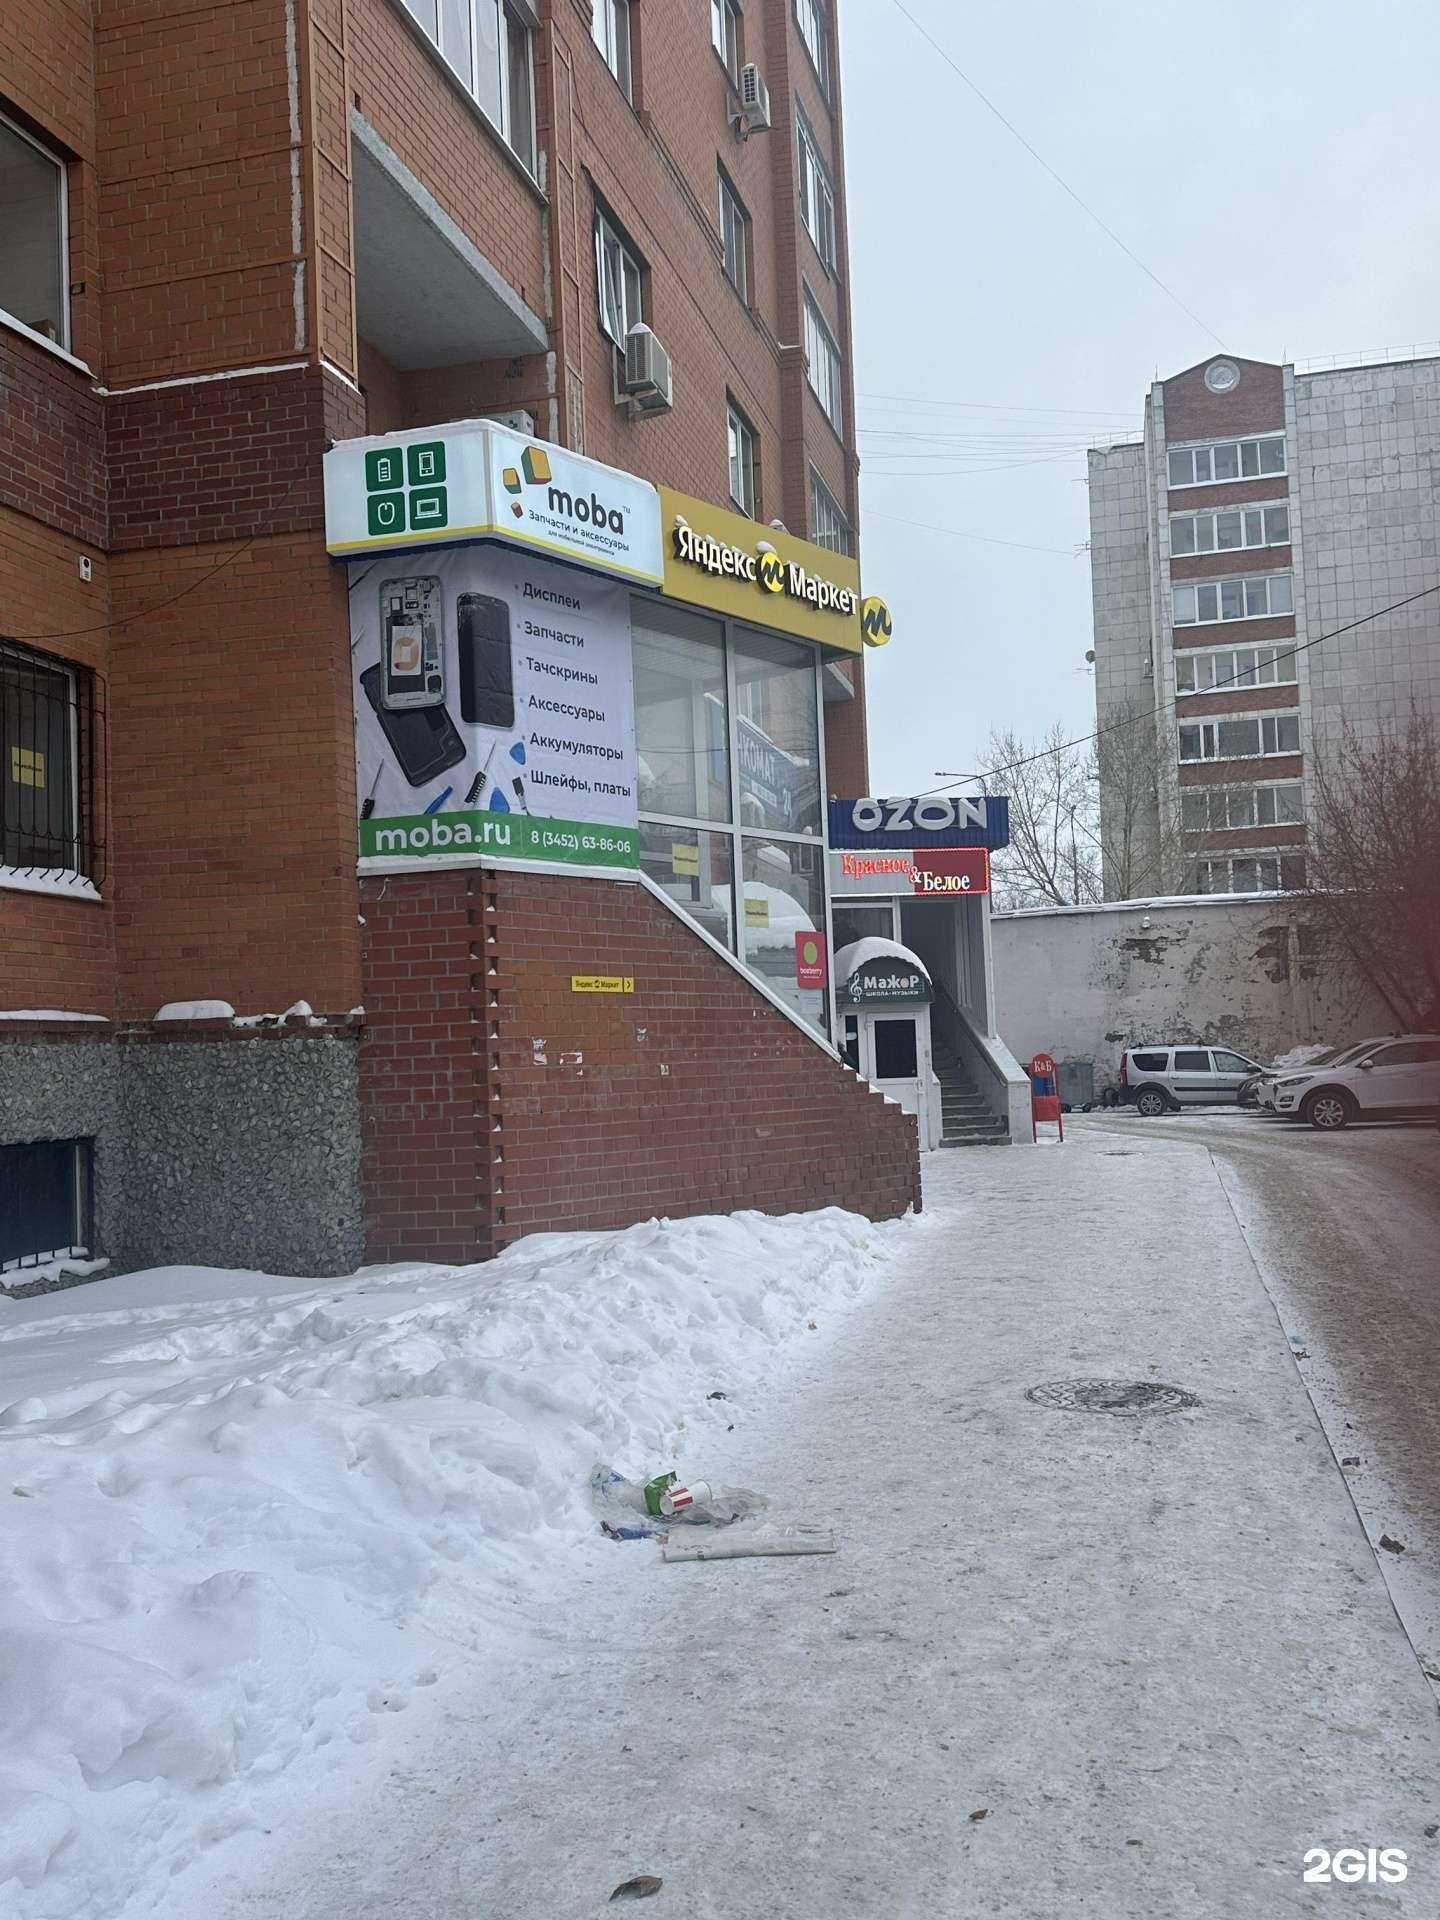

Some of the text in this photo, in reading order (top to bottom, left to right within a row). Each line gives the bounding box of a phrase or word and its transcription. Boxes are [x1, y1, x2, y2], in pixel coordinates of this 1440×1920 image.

[548, 486, 624, 535] moba
[528, 509, 630, 552] Запчасти и аксессуары
[678, 525, 757, 581] Яндекс
[789, 563, 859, 615] Маркет
[523, 581, 581, 611] Дисплеи
[524, 621, 585, 648] Запчасти
[526, 657, 598, 685] Тачскрины
[528, 695, 605, 722] Аксессуары
[530, 732, 624, 760] Аккумуляторы
[531, 769, 632, 798] Шлейфы, платы
[852, 797, 988, 832] OZON
[375, 819, 512, 851] moba.ru
[531, 831, 632, 854] 8 (3452) 63-86-06
[842, 854, 970, 891] Красное & Белое
